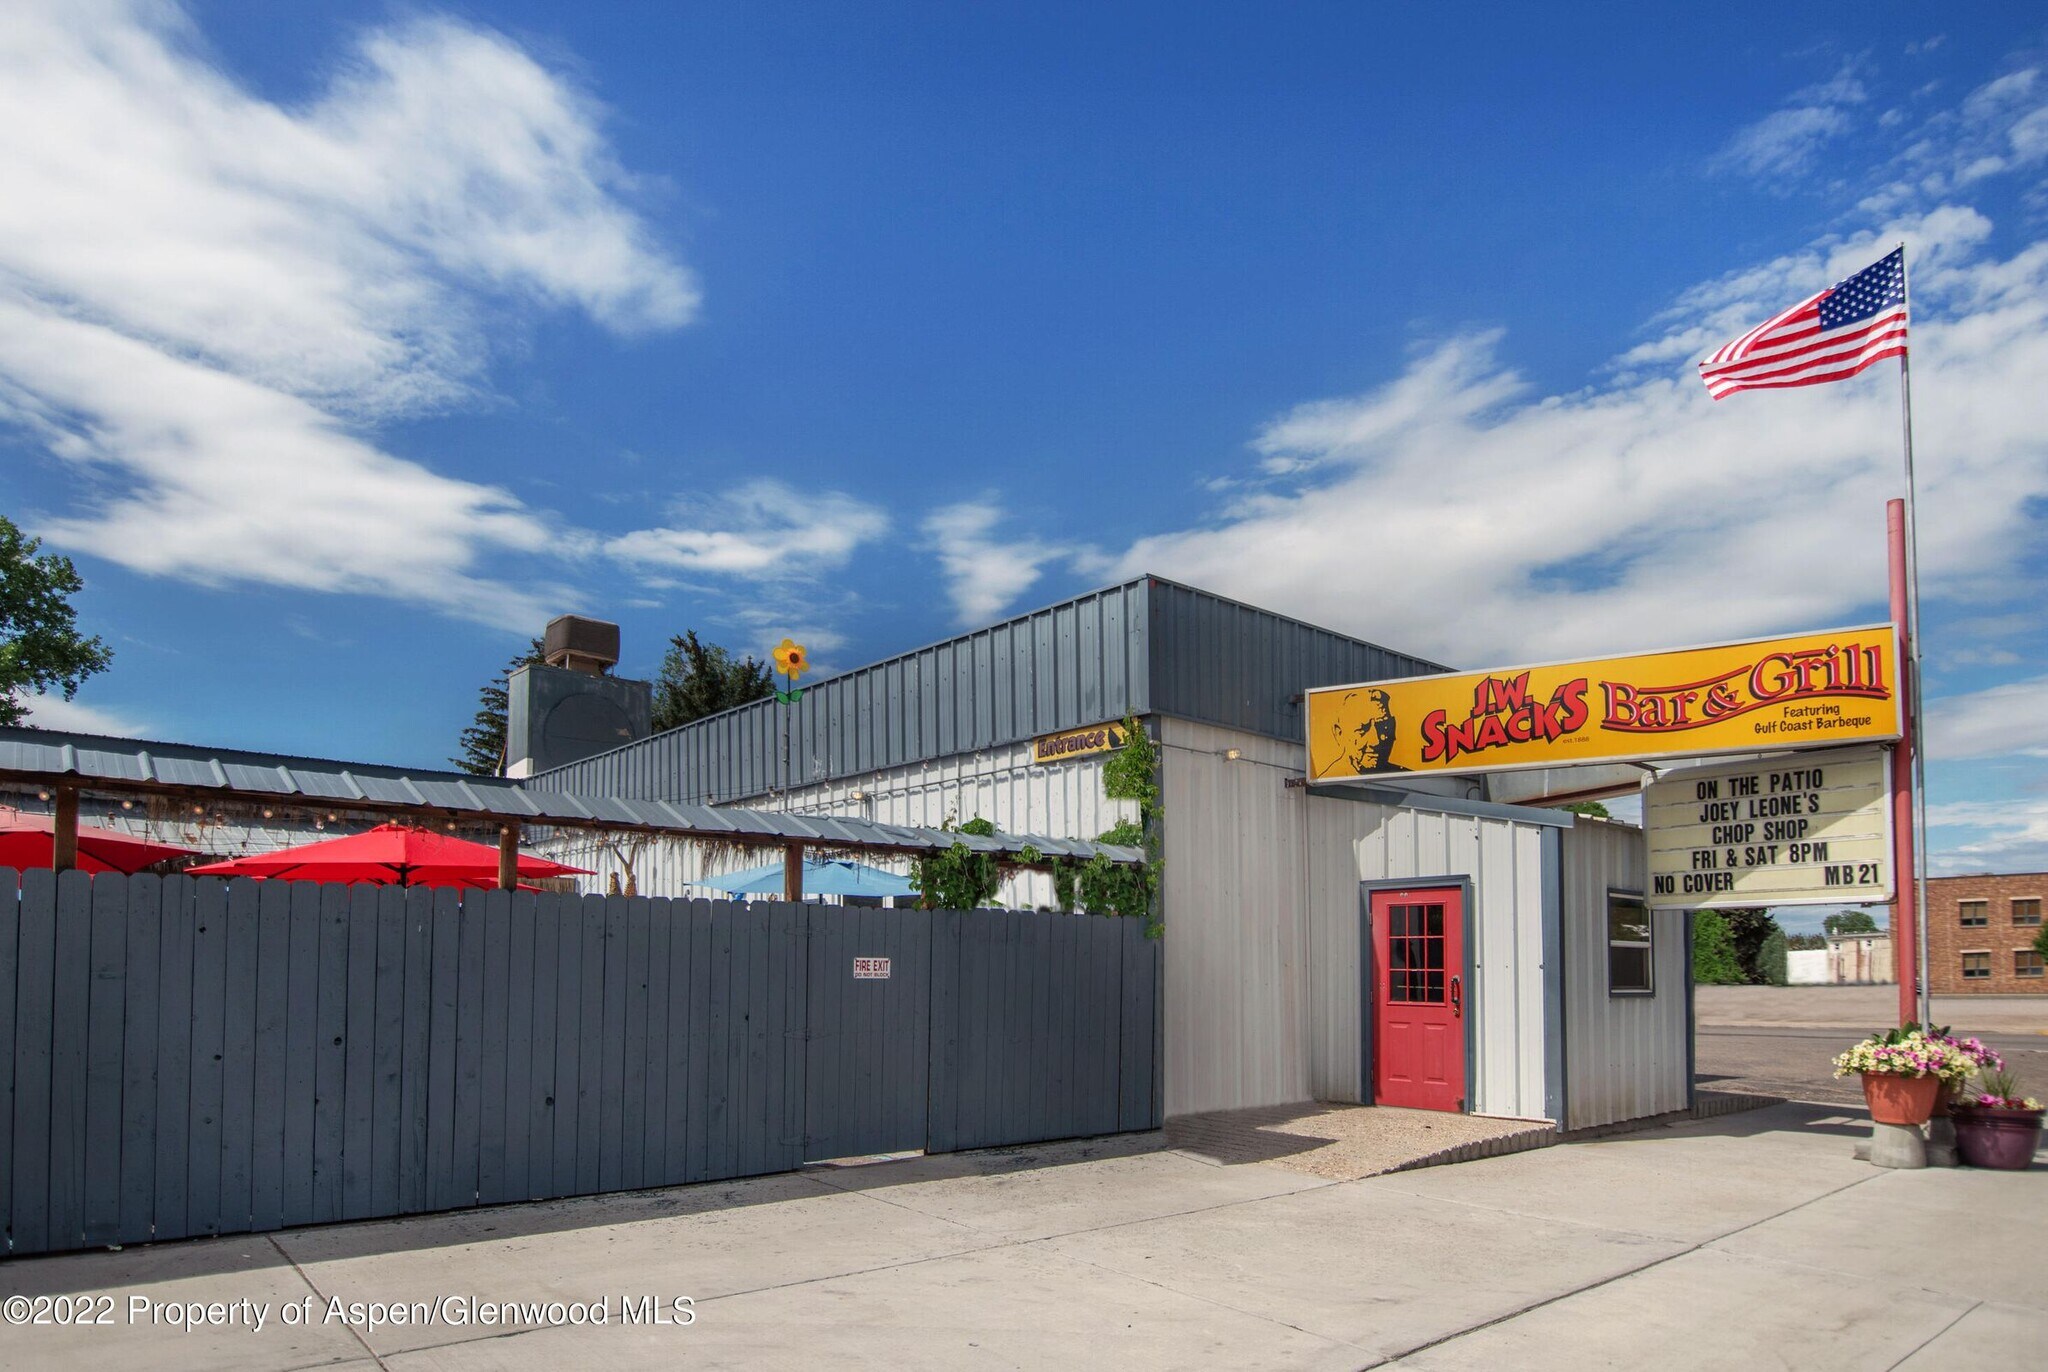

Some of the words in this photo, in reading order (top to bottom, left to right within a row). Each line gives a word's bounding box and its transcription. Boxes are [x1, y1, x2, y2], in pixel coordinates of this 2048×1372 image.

[1470, 671, 1534, 718] J.W.
[1599, 680, 1699, 727] Bar
[1702, 682, 1746, 717] &
[1749, 643, 1889, 701] Grill
[1421, 678, 1589, 764] SNACK'S
[1754, 720, 1778, 734] Gulf
[1780, 718, 1813, 732] Coast
[1816, 715, 1872, 731] Barbeque
[1783, 704, 1840, 719] Featuring
[1038, 730, 1106, 758] Entrance
[1697, 780, 1718, 800] ON
[1729, 776, 1759, 796] THE
[1770, 768, 1823, 793] PATIO
[1700, 801, 1740, 823] JOEY
[1750, 793, 1820, 818] LEONE'S
[1712, 824, 1754, 845] CHOP
[1764, 818, 1808, 841] SHOP
[1692, 850, 1717, 870] FRI
[1726, 848, 1737, 867] &
[1745, 845, 1777, 866] SAT
[1789, 841, 1828, 863] 8PM
[1654, 875, 1675, 894] NO
[1683, 872, 1734, 892] COVER
[855, 960, 871, 971] FIRE
[873, 960, 889, 971] EXIT
